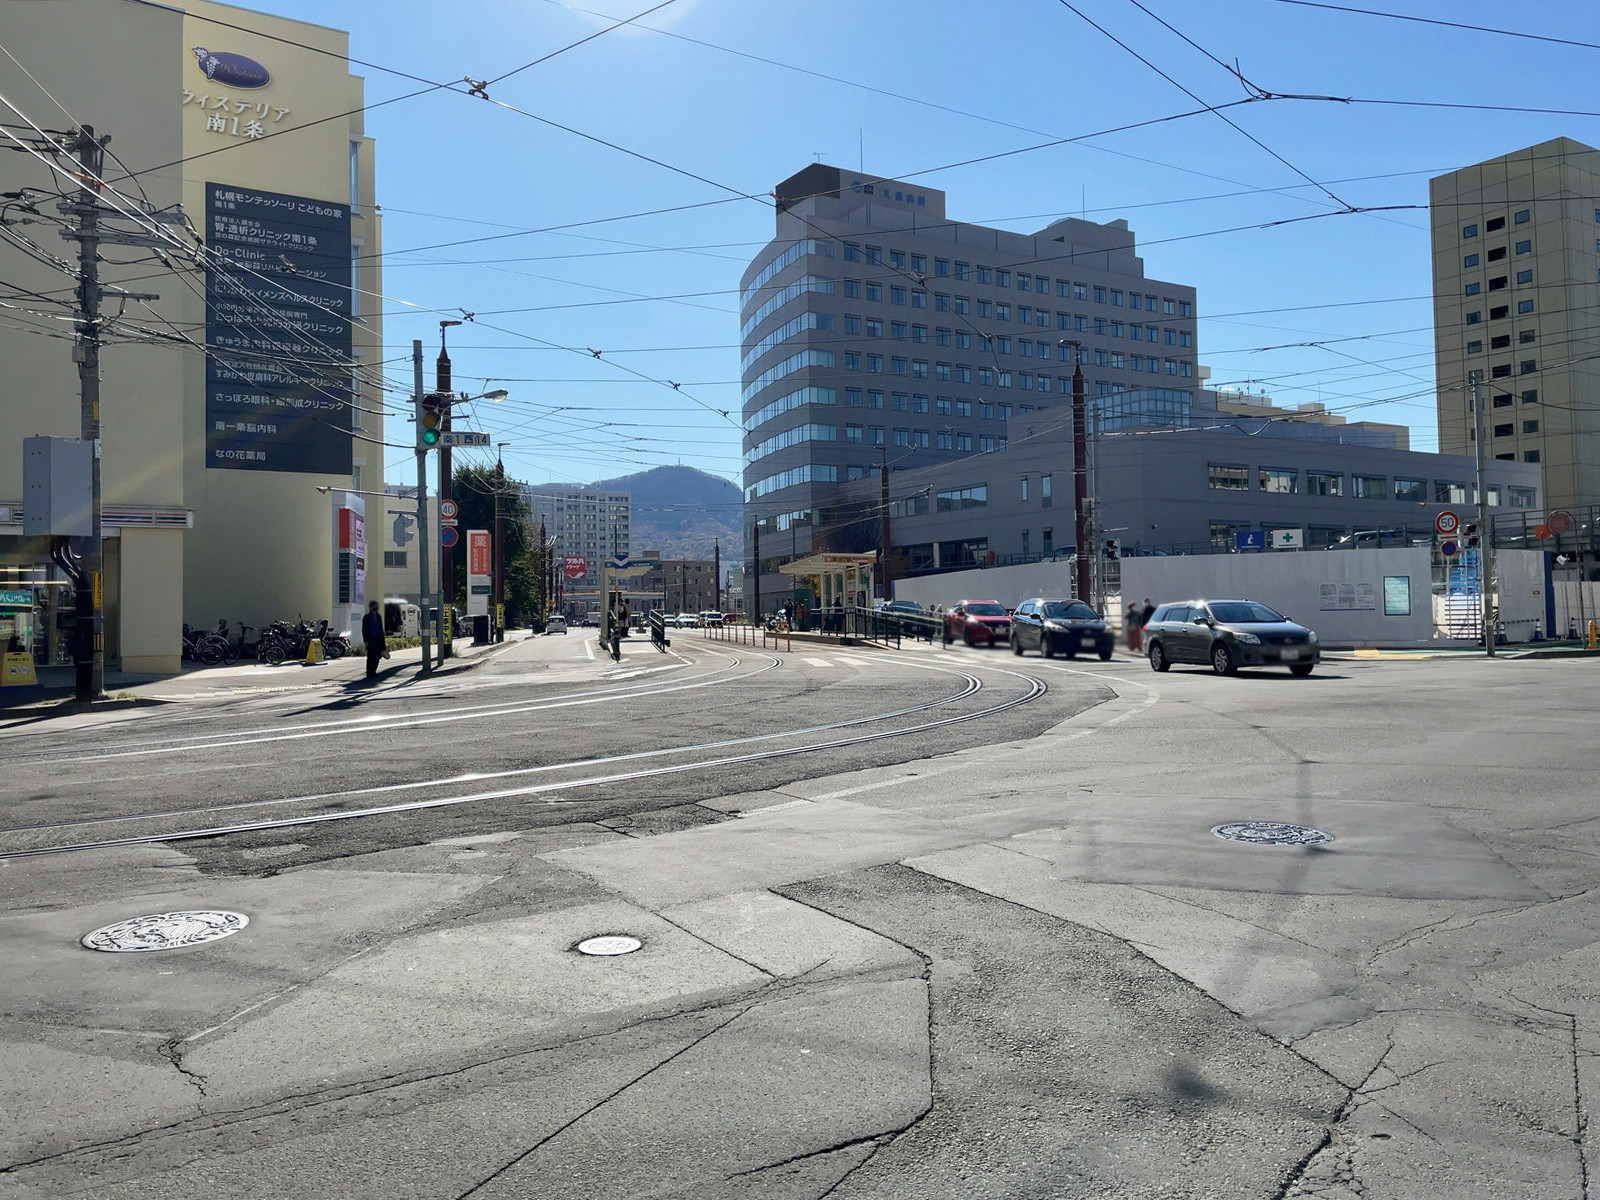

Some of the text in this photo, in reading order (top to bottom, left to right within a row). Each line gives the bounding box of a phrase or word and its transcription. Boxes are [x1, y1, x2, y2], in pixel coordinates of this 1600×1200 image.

[183, 89, 291, 123] ウィステリア
[206, 112, 264, 139] 南1条
[215, 245, 266, 261] Do-Clinic
[443, 505, 453, 514] 40
[1441, 517, 1455, 528] 50
